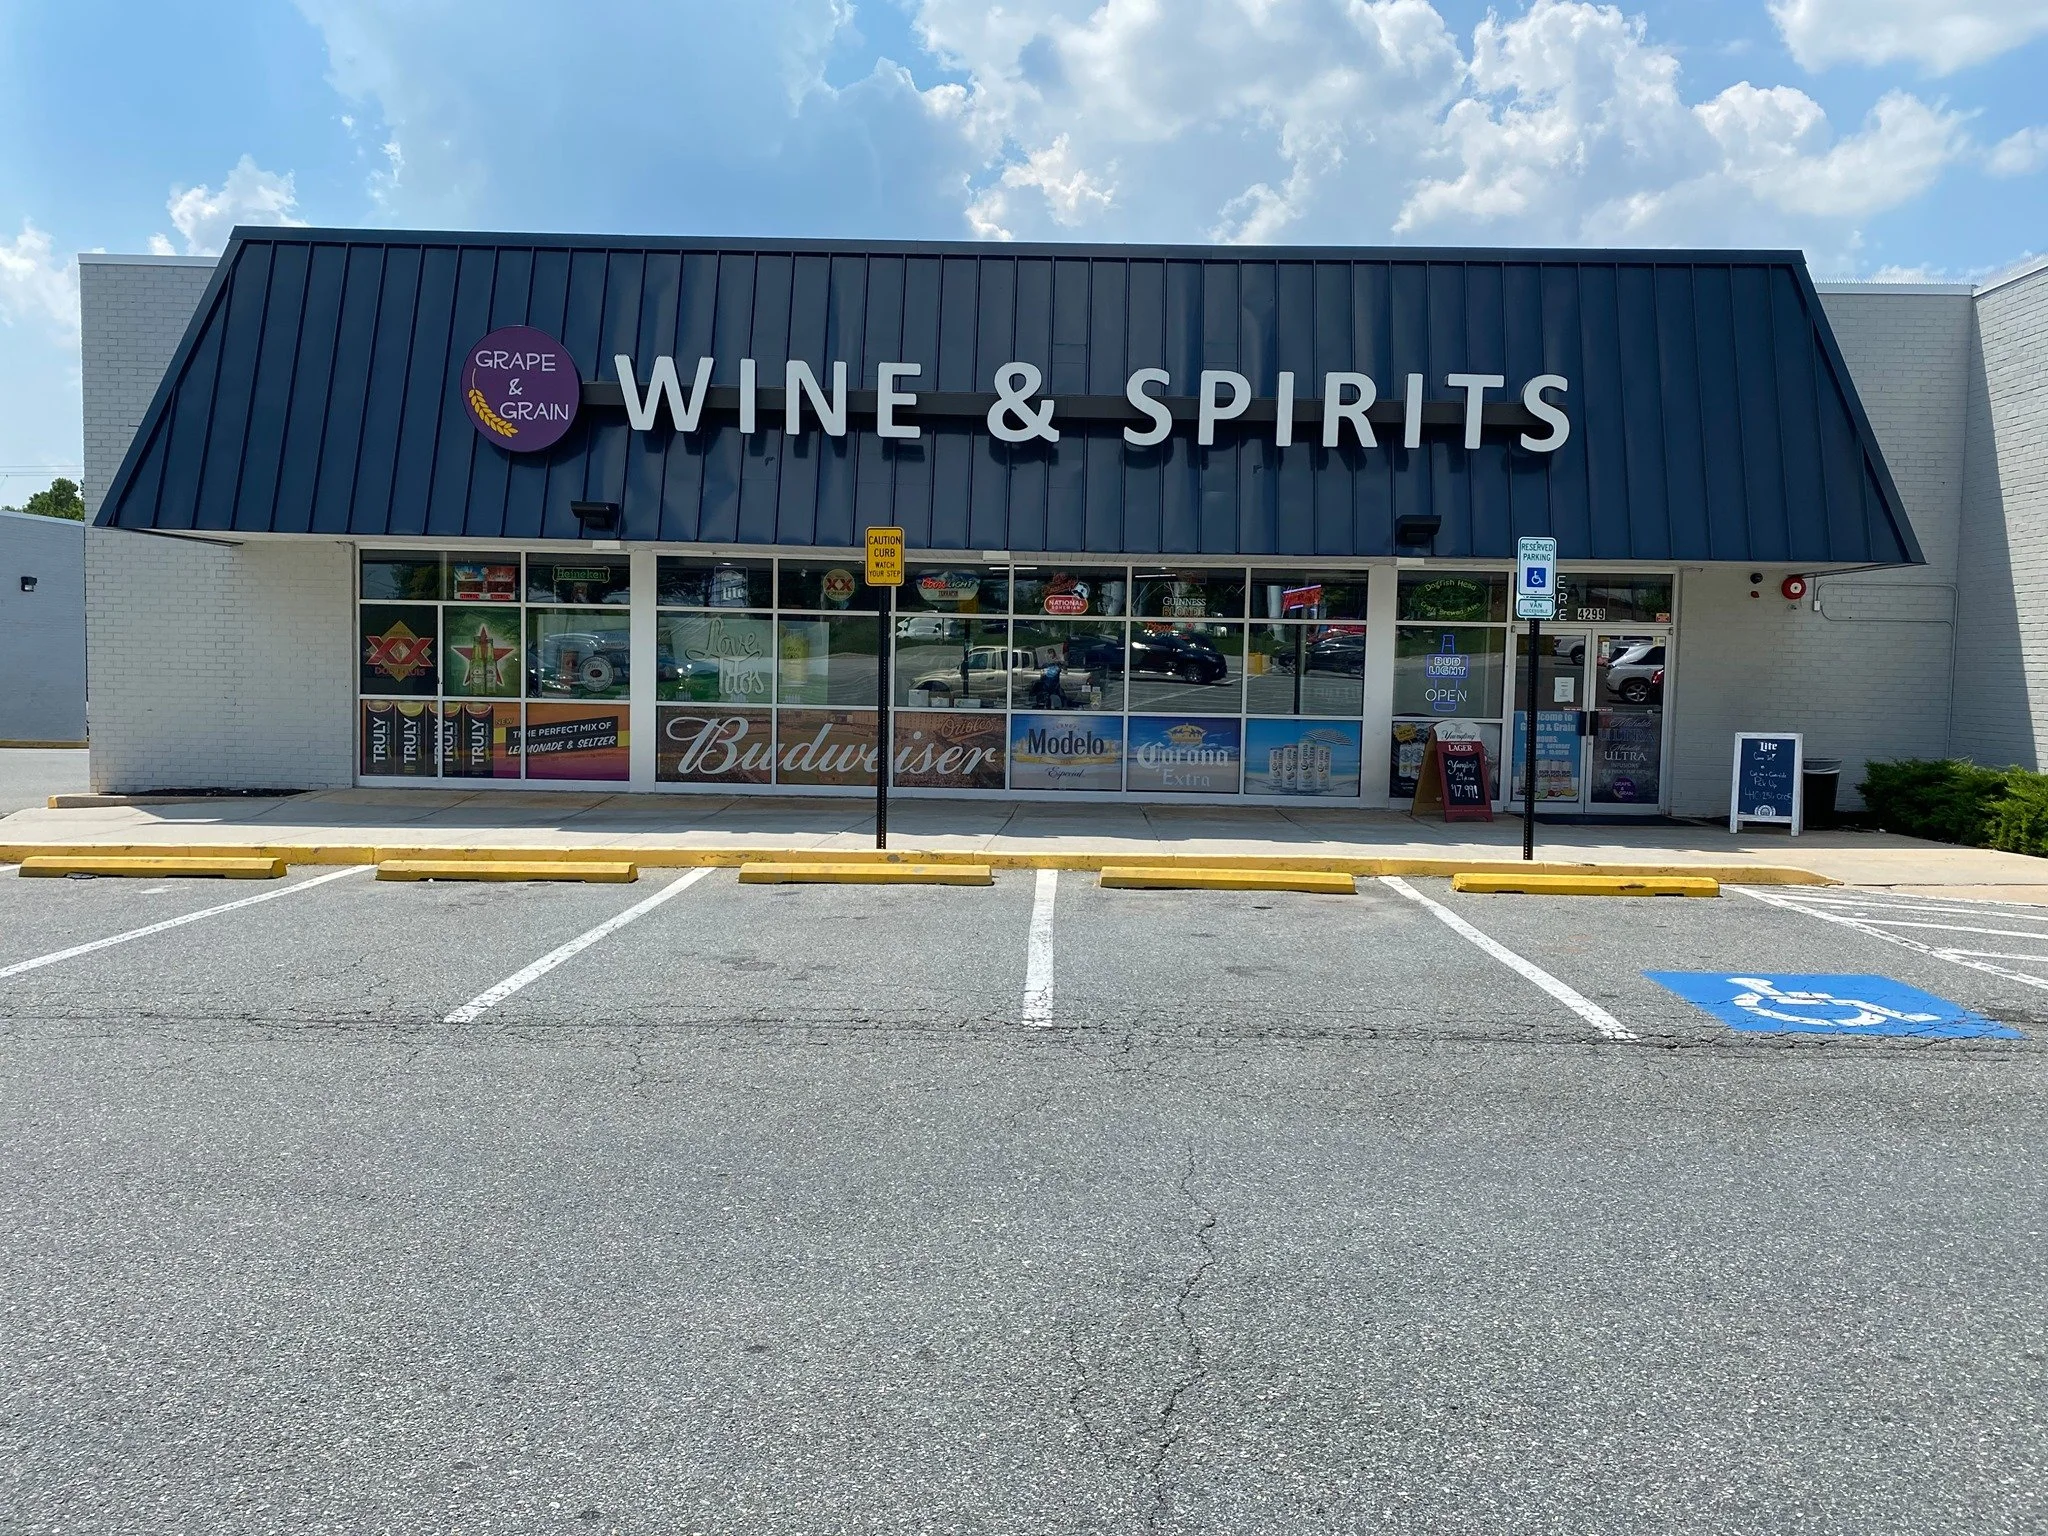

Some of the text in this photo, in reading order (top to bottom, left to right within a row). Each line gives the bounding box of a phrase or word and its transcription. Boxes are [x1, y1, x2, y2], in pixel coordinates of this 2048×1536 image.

[475, 350, 556, 372] GRAPE
[508, 378, 523, 396] &
[614, 354, 1570, 452] WINE & SPIRITS
[500, 402, 569, 421] GRAIN
[868, 536, 901, 545] CAUTION
[1521, 543, 1554, 552] RESERVED
[874, 549, 896, 557] CURB
[1522, 553, 1551, 562] PARKING
[557, 567, 606, 581] Heineken
[922, 576, 975, 590] Coors LIGHT
[1424, 579, 1477, 592] Dogfish Head
[1162, 596, 1207, 606] GUINNESS
[1162, 606, 1206, 617] BLONDE
[1578, 608, 1605, 620] 4299
[1434, 656, 1461, 666] BUD
[1428, 665, 1467, 676] LIGHT
[1425, 688, 1468, 703] OPEN
[1564, 712, 1573, 722] to
[538, 725, 578, 736] PERFECT
[580, 723, 597, 731] MIX
[598, 721, 612, 730] OF
[940, 717, 996, 741] Orioles
[1553, 723, 1576, 732] Grain
[373, 717, 386, 763] TRULY
[403, 717, 416, 764] TRULY
[471, 718, 484, 765] TRULY
[566, 740, 574, 749] &
[576, 735, 617, 749] SELTZER
[666, 712, 997, 774] Budweiser
[1028, 728, 1105, 756] Modelo
[1760, 741, 1778, 752] Lite
[1448, 744, 1473, 752] LAGER
[1136, 741, 1230, 773] Corona
[1604, 751, 1648, 761] ULTRA
[1046, 766, 1085, 780] Especial
[1162, 768, 1211, 787] Extra
[1450, 784, 1479, 799] $17.99!
